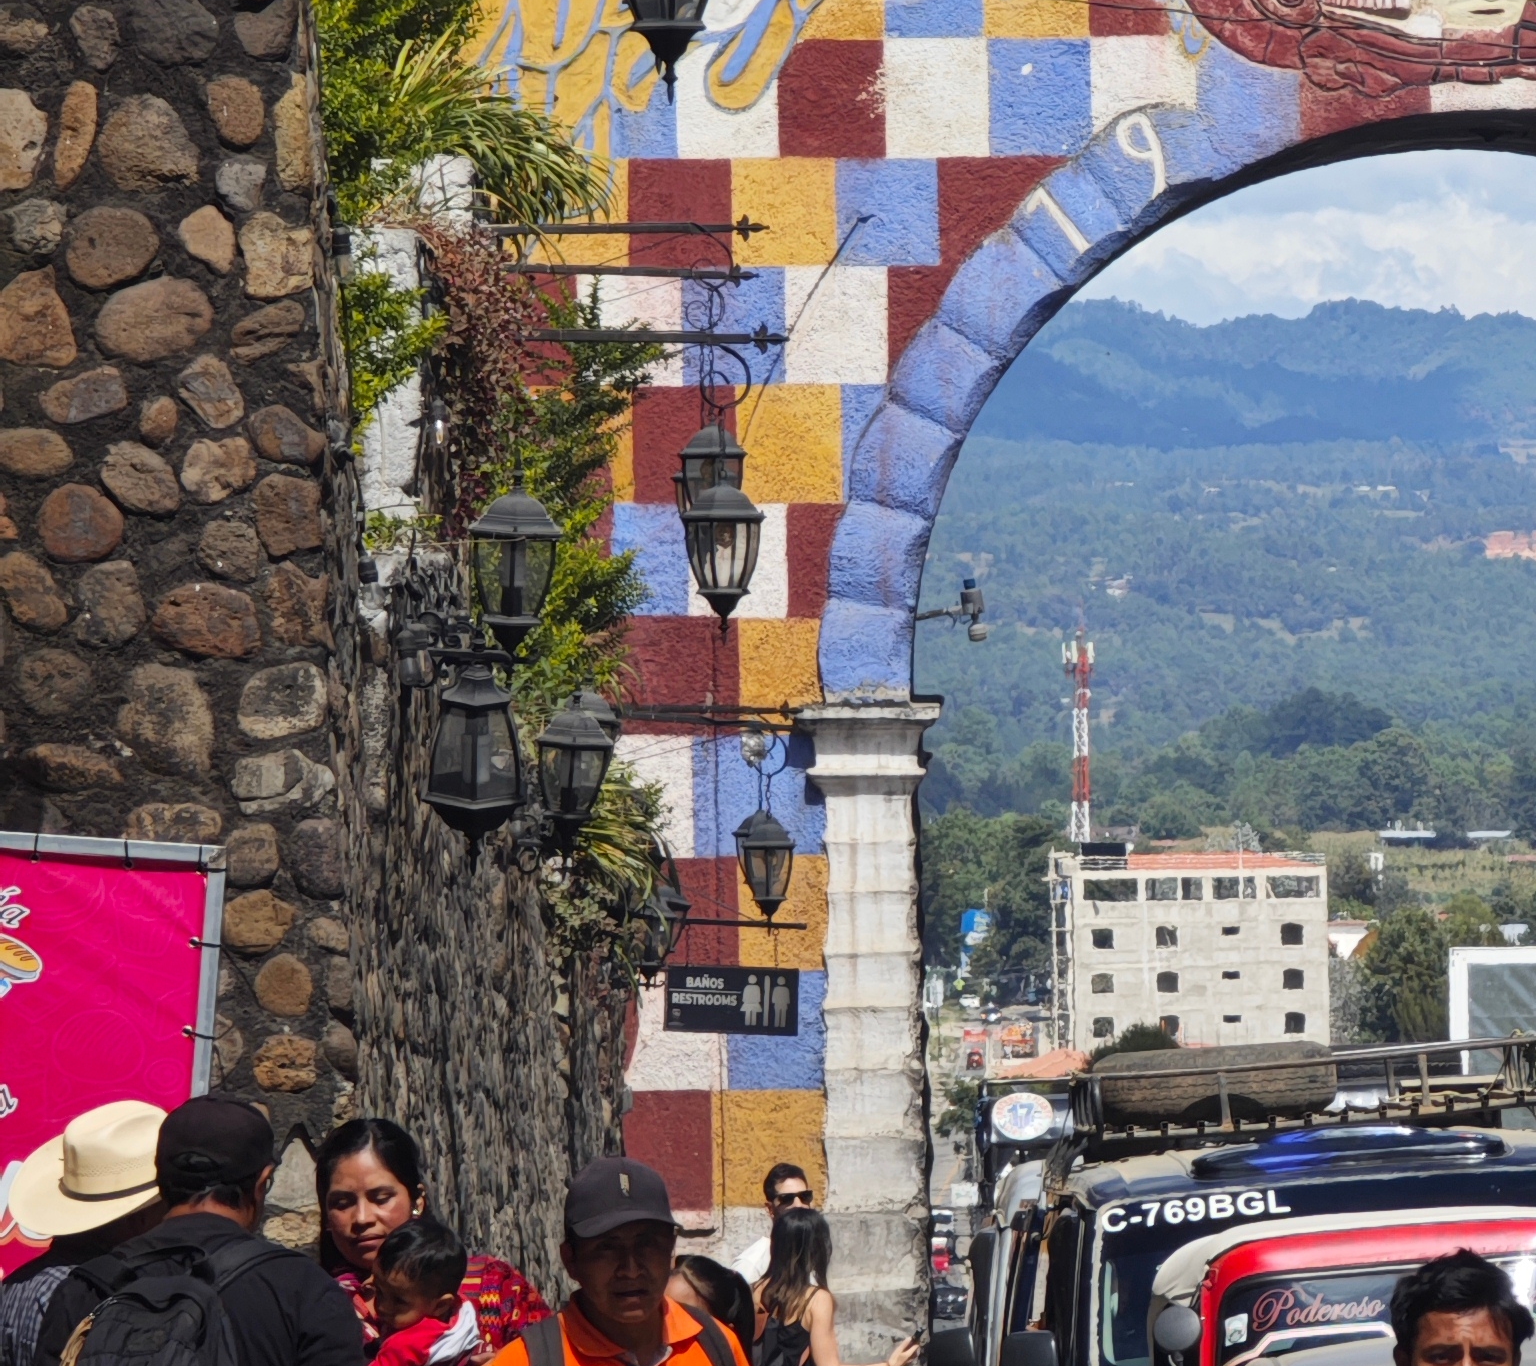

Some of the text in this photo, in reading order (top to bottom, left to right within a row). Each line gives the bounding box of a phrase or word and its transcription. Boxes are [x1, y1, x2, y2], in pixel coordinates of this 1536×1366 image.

[685, 974, 724, 989] BAÑOS
[672, 993, 738, 1006] RESTROOMS
[1101, 1189, 1292, 1233] C-769BGL
[1252, 1288, 1386, 1332] Poderoso
